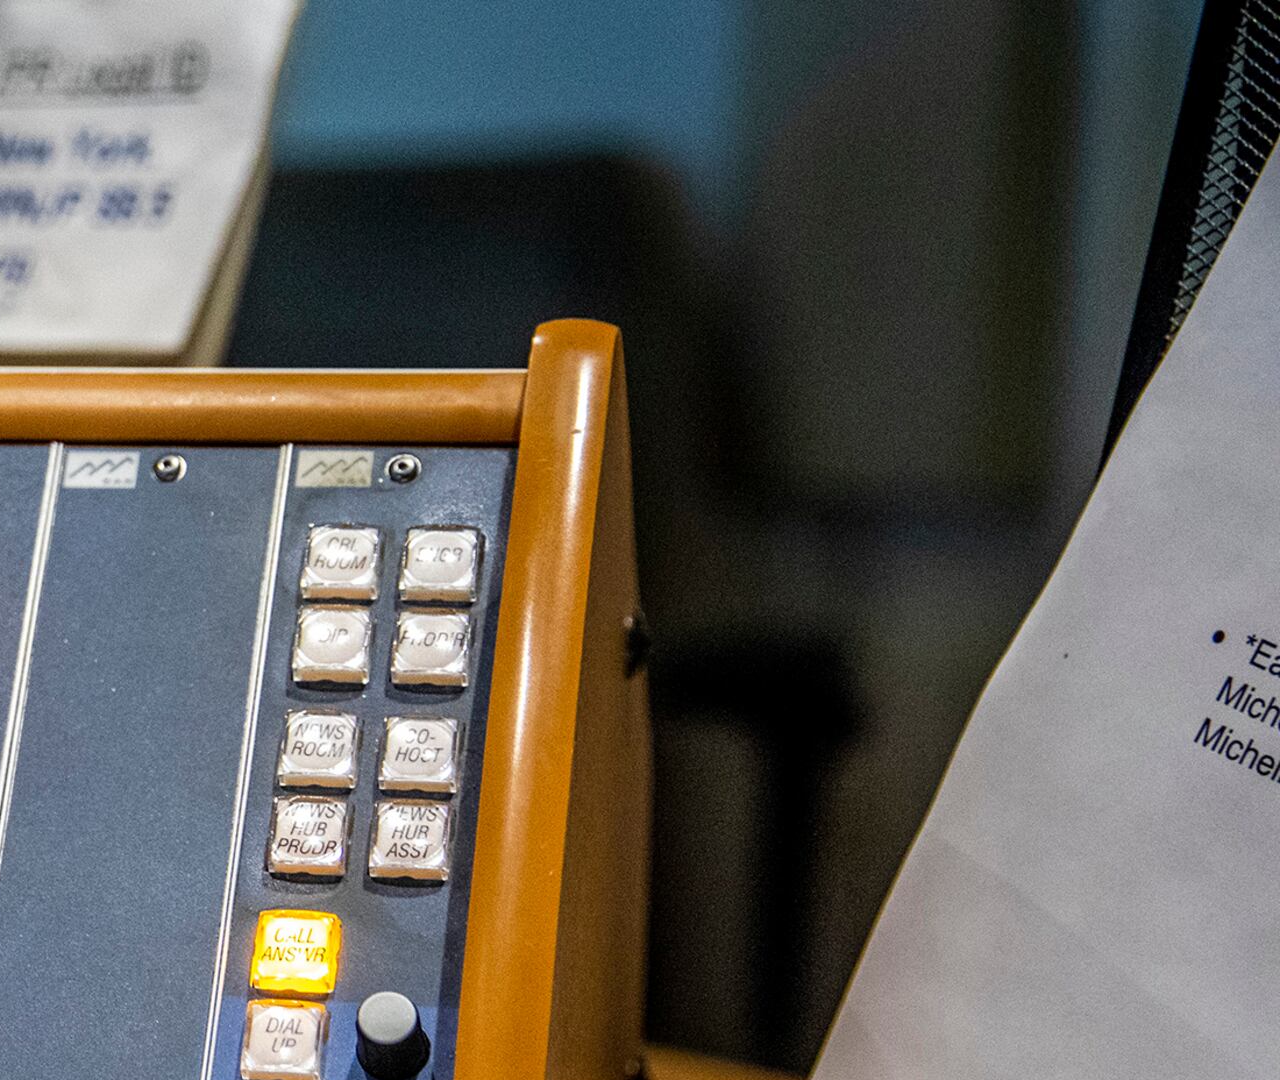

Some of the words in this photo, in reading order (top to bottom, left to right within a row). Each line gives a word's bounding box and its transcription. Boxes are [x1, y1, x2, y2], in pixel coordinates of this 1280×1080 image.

[1215, 675, 1280, 734] Mich
[1193, 717, 1280, 784] Michel
[385, 843, 433, 859] ASST
[265, 1017, 305, 1035] DIAL
